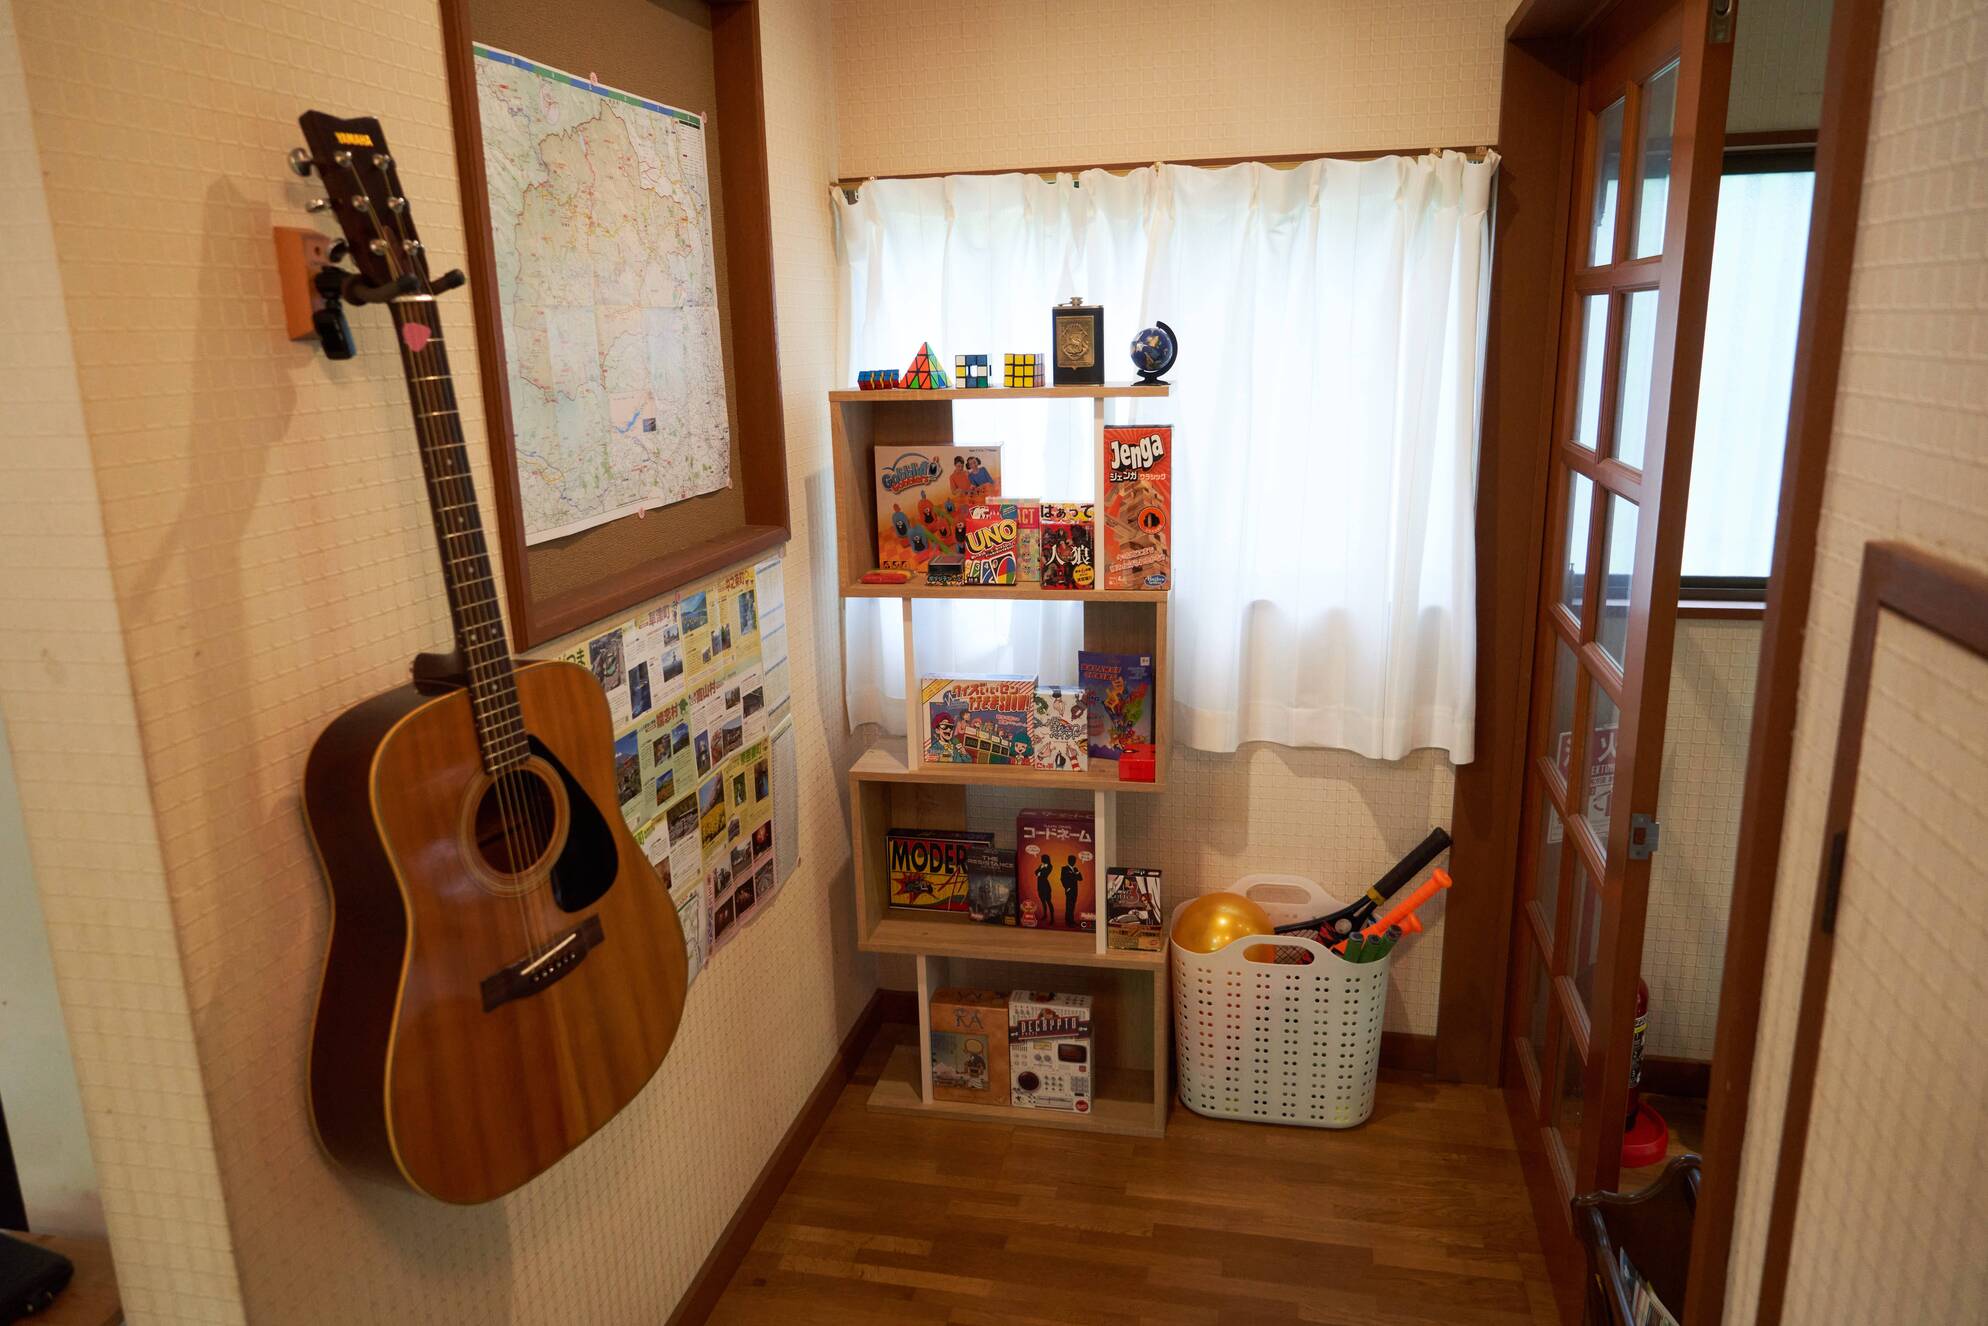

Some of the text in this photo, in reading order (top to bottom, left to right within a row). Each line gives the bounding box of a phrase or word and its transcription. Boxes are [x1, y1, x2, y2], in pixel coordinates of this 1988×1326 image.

[1110, 434, 1164, 471] Jenga
[1109, 471, 1137, 482] ジェンガ
[966, 519, 1017, 553] UNO
[1045, 544, 1092, 566] 人狼
[1023, 826, 1092, 843] コードネーム
[953, 1007, 984, 1030] RA
[1020, 1016, 1077, 1033] DECRYPTO
